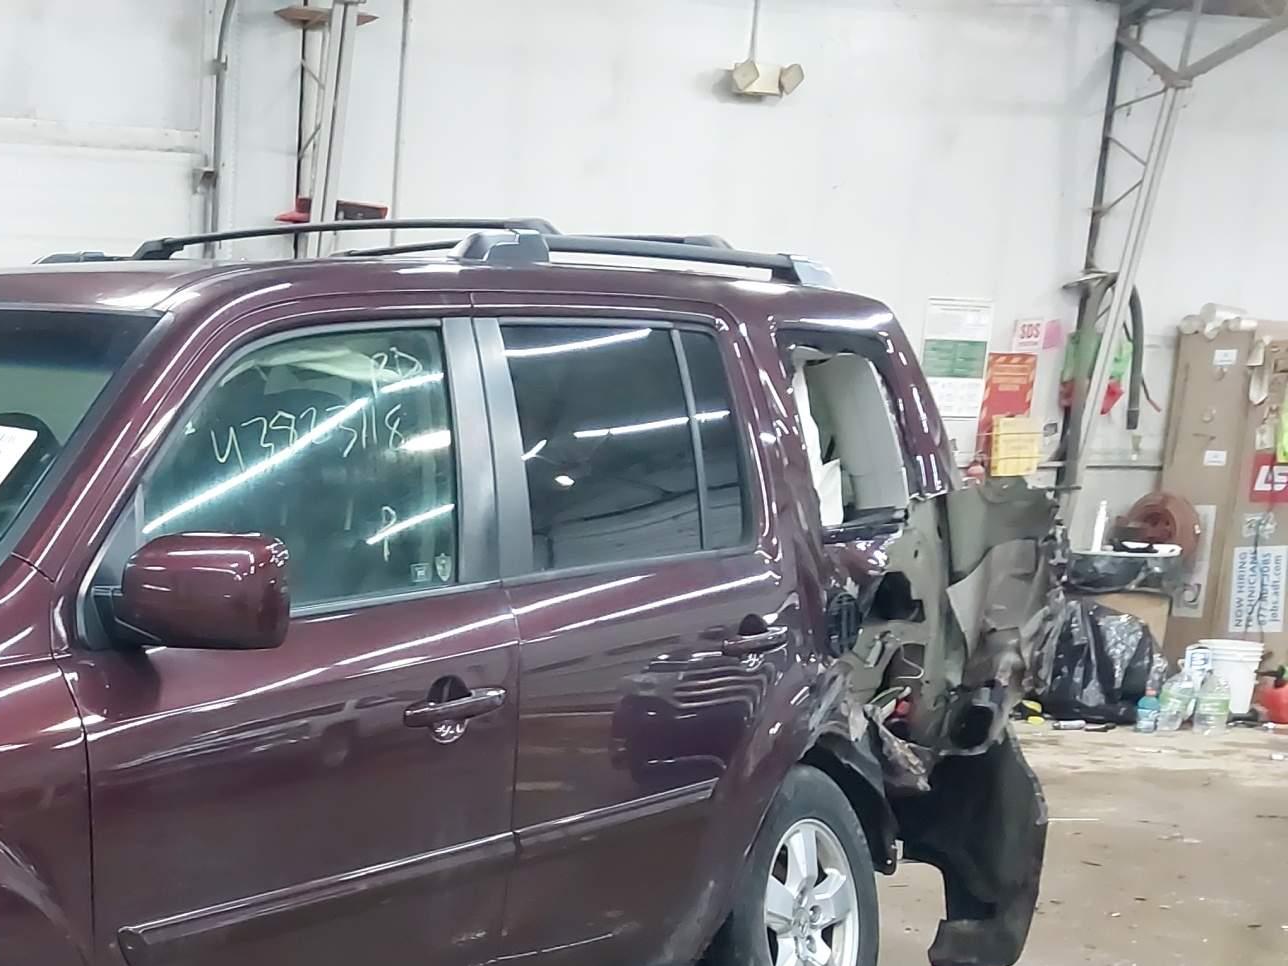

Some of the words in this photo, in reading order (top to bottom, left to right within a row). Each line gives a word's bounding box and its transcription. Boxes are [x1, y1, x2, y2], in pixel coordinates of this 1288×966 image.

[1020, 323, 1041, 340] SDS
[1236, 552, 1249, 594] HIRING
[1234, 596, 1246, 628] NOW
